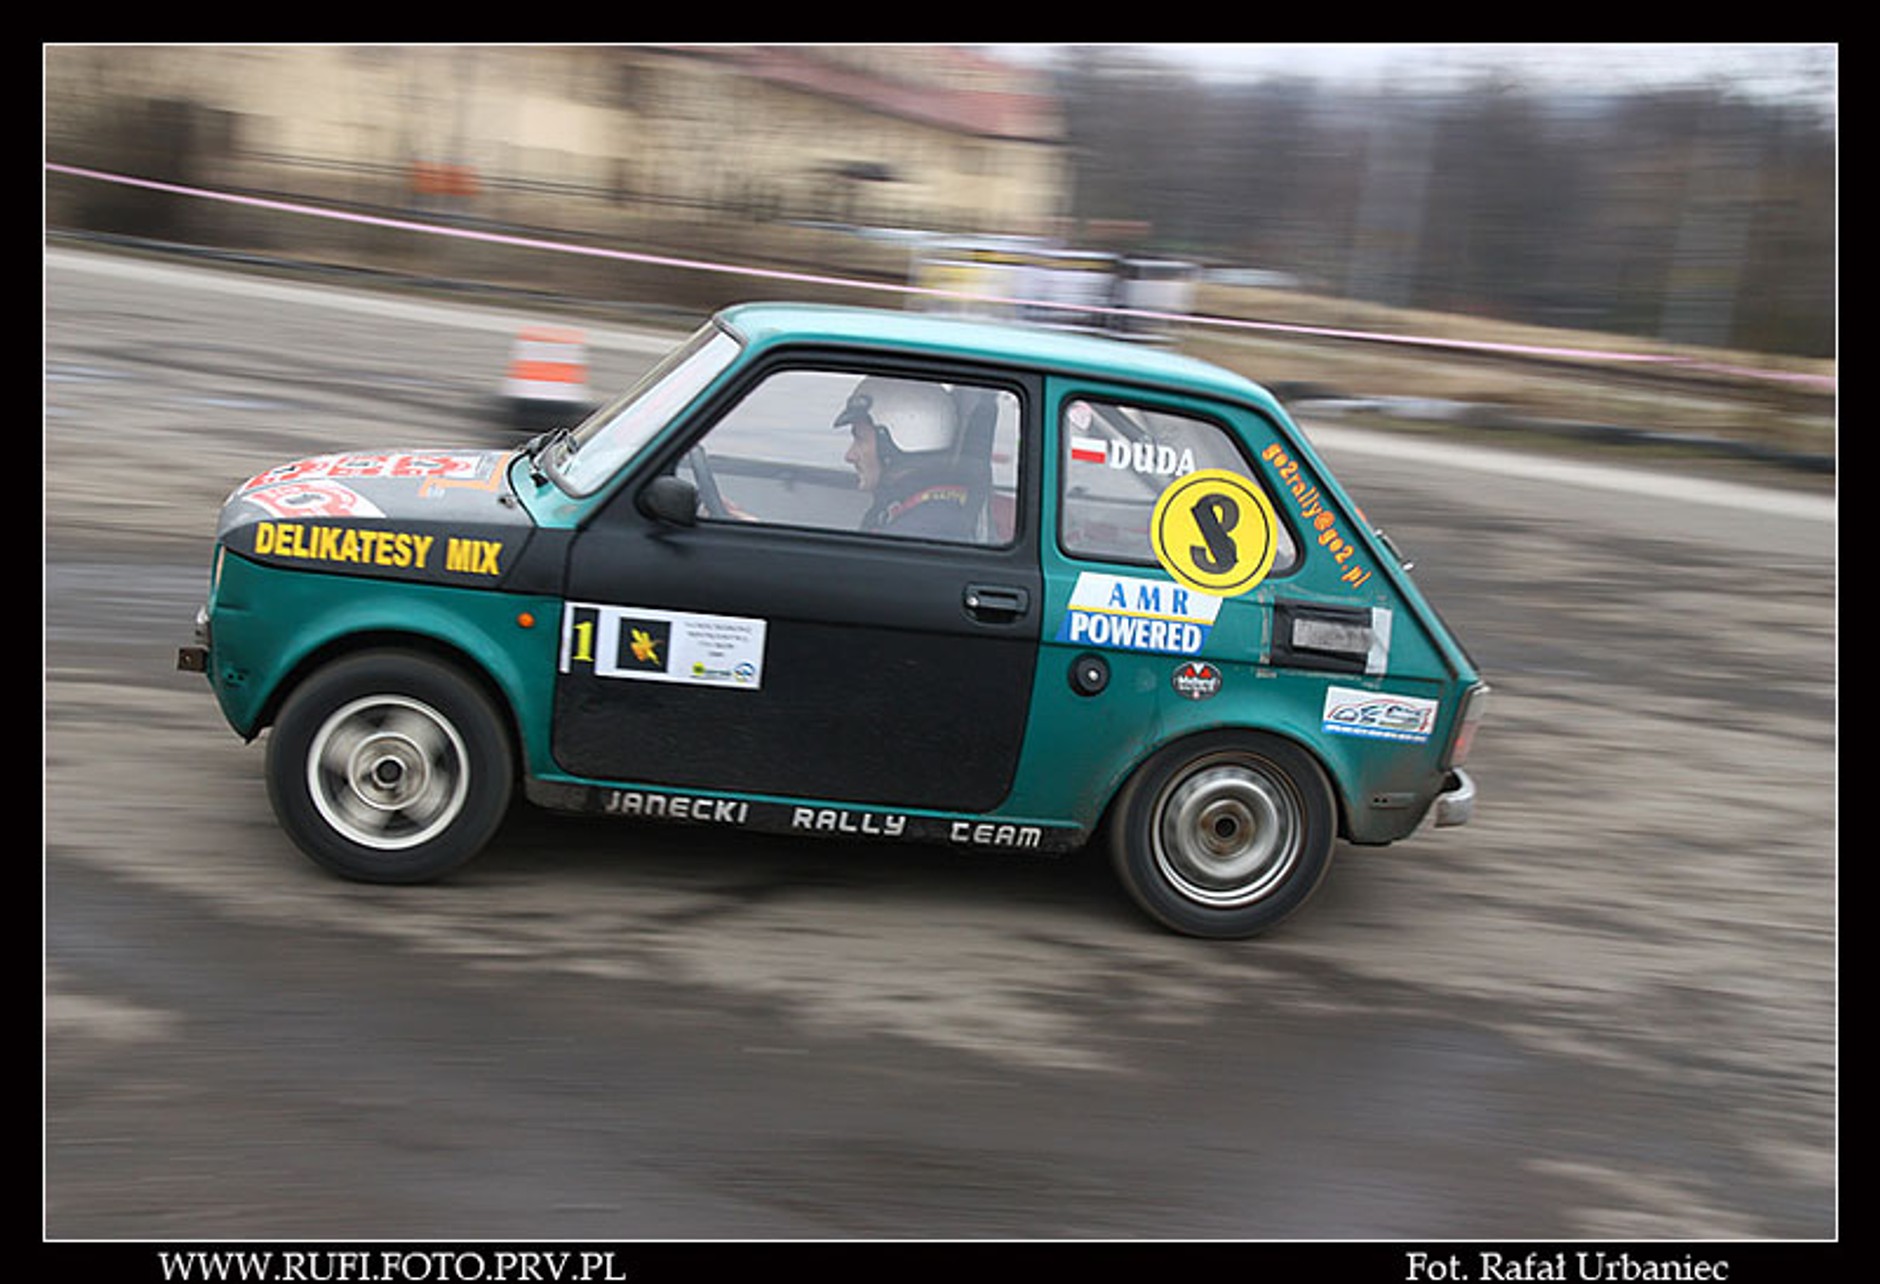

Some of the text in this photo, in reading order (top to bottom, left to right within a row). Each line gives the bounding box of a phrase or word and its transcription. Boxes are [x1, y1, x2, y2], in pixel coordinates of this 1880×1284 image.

[1109, 439, 1196, 477] DUDA
[1262, 443, 1372, 589] go2rally@go2.pl
[256, 522, 503, 575] DELIKATESY MIX
[572, 621, 595, 662] 1
[1069, 613, 1202, 654] POWERED
[605, 791, 1042, 848] JANECKI RALLY TEAM
